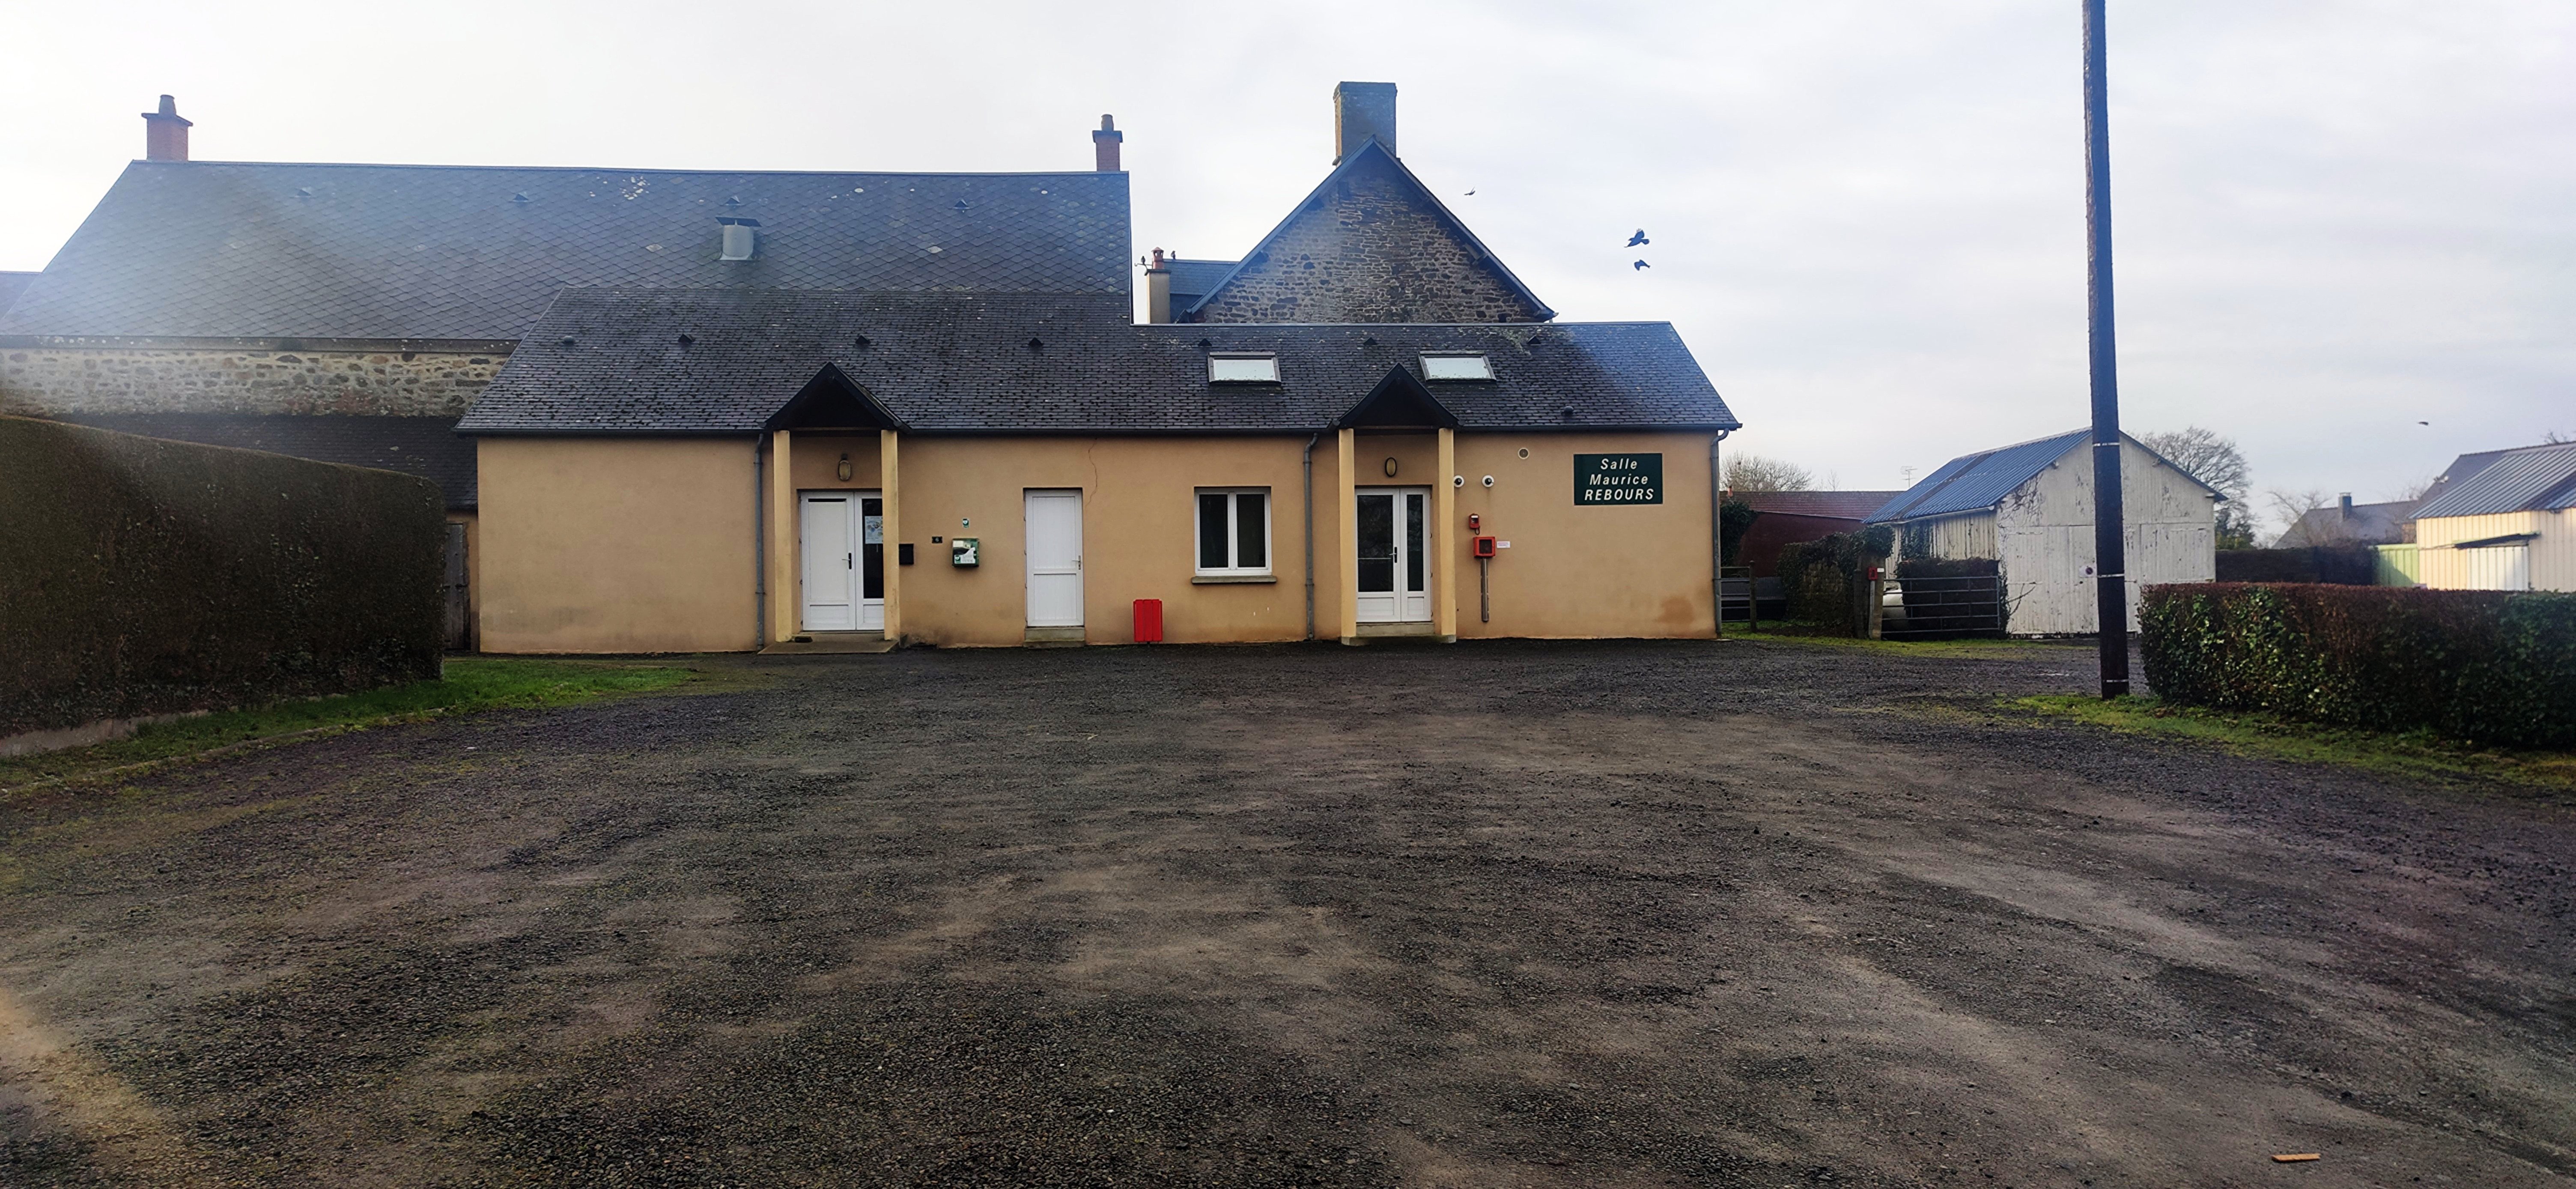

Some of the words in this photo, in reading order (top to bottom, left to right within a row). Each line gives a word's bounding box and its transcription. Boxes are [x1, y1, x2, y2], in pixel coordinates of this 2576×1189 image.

[1600, 458, 1637, 470] Salle
[1589, 474, 1648, 485] Maurice
[1584, 488, 1654, 501] REBOURS
